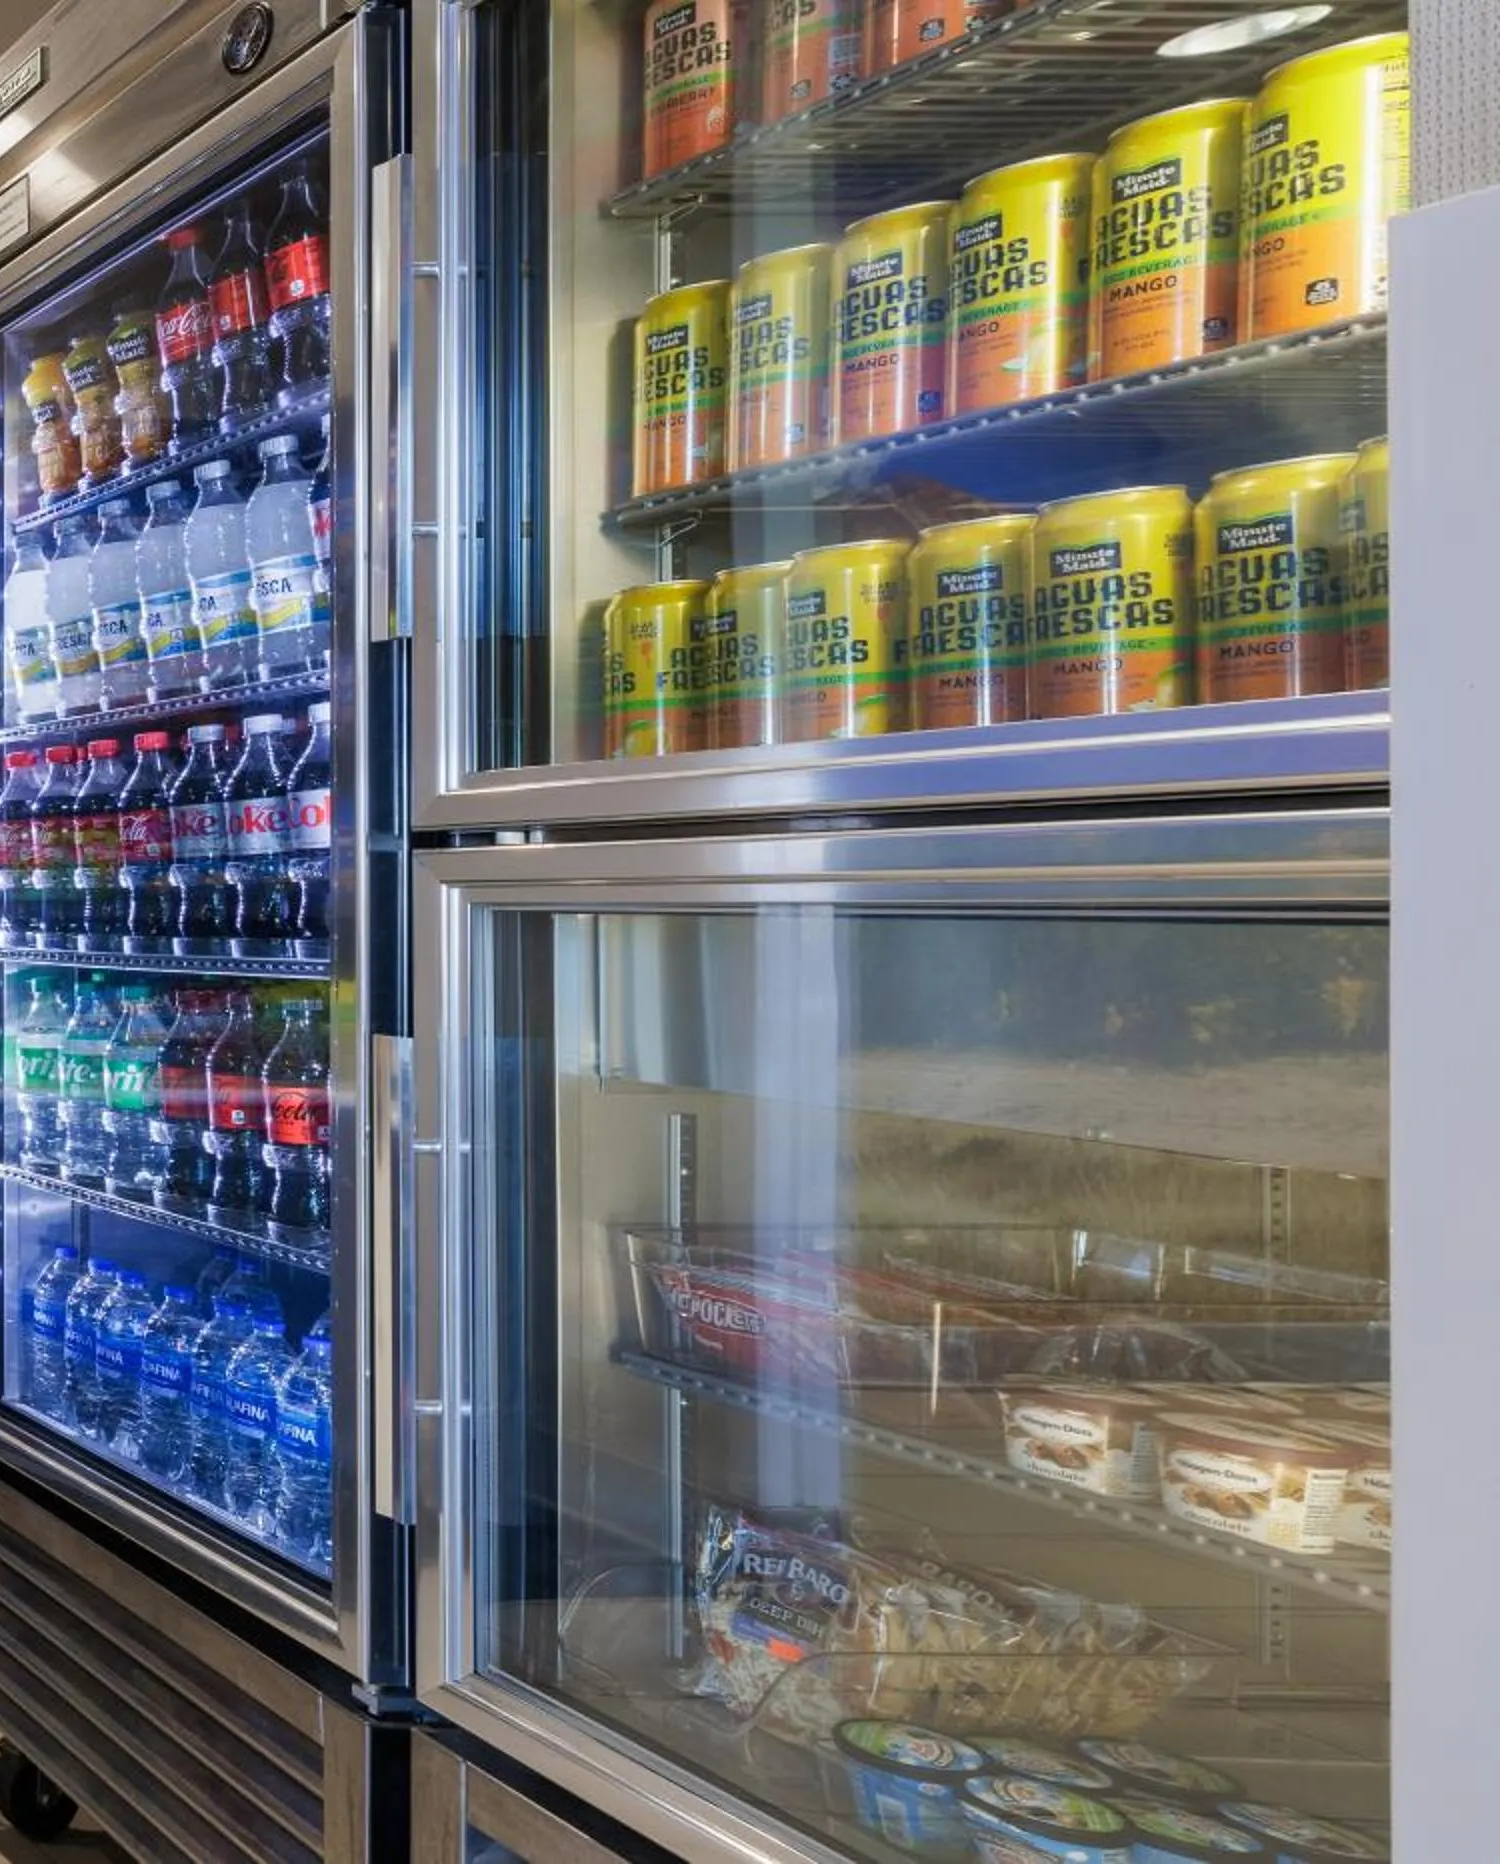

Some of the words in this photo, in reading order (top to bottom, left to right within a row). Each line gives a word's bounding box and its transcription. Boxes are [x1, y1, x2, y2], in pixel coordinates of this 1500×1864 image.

[1095, 210, 1236, 271] RESCAS
[1109, 274, 1178, 303] MANGO
[1221, 521, 1288, 542] Minute
[1228, 532, 1281, 550] Maid
[1054, 548, 1116, 566] Minute
[1061, 556, 1109, 574] Maid
[1219, 640, 1295, 660] MANGO
